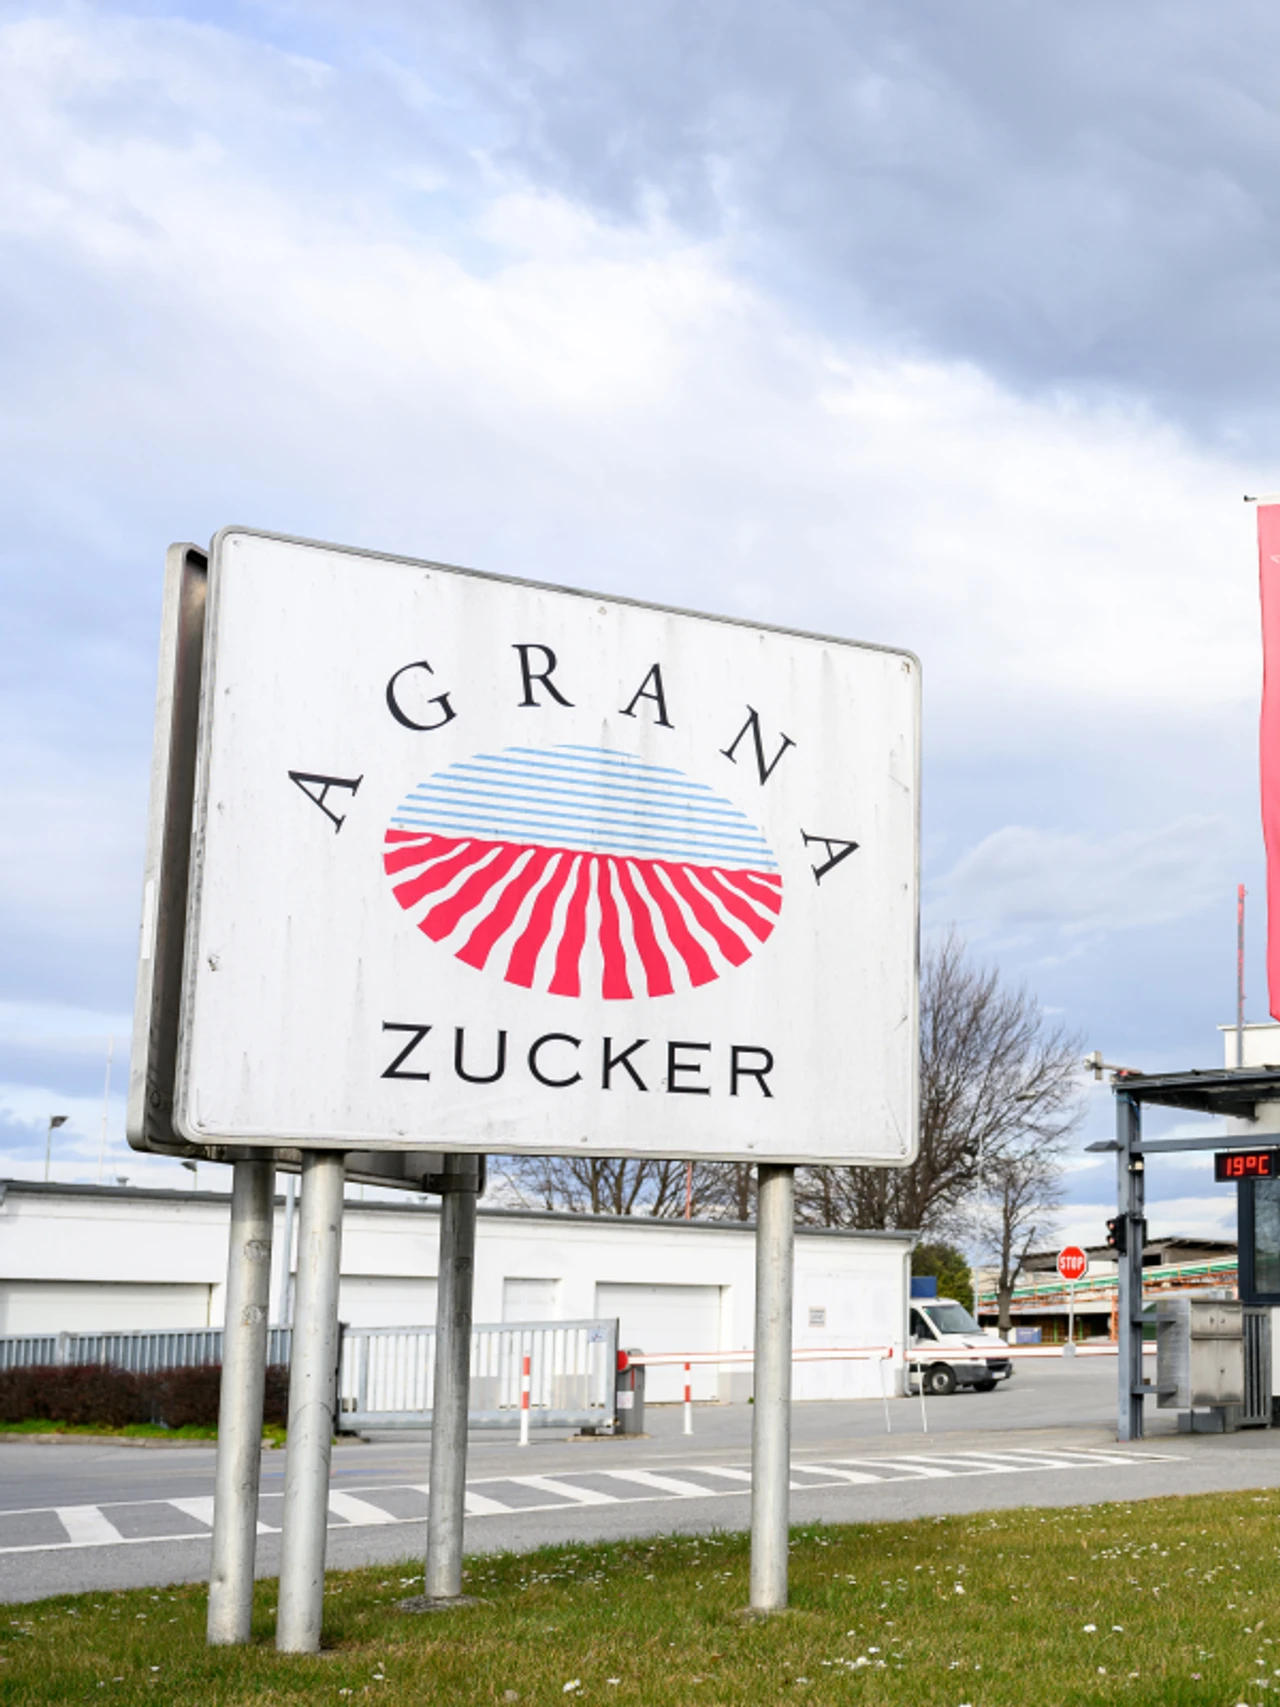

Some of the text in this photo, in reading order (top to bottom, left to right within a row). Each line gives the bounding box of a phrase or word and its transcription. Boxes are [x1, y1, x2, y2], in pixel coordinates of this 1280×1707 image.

[288, 643, 860, 886] AGRANA
[380, 1021, 776, 1099] ZUCKER
[1059, 1256, 1084, 1271] STOP
